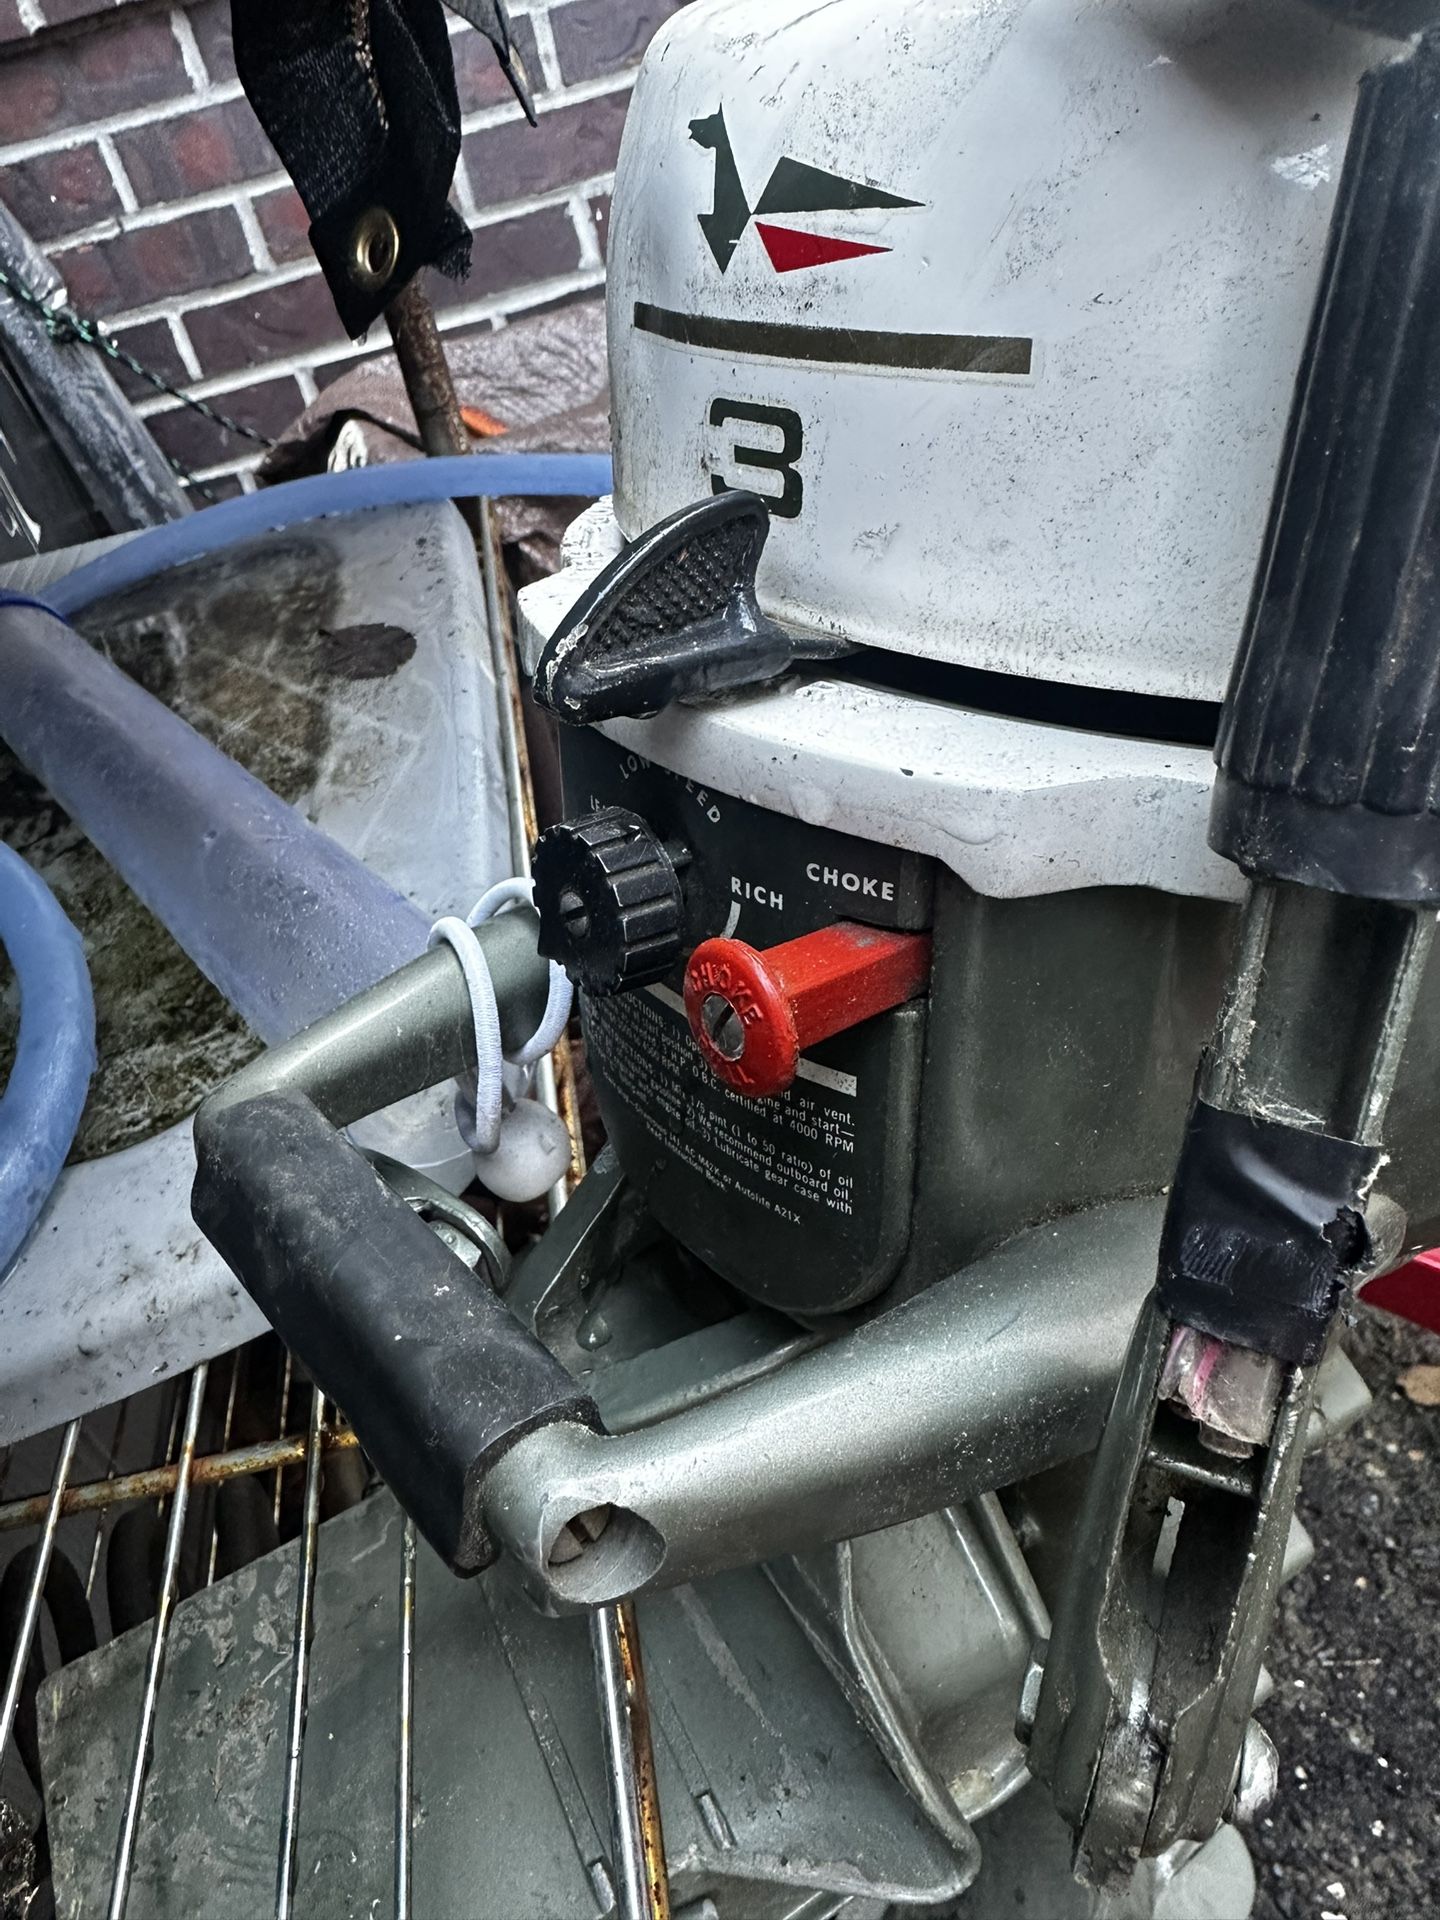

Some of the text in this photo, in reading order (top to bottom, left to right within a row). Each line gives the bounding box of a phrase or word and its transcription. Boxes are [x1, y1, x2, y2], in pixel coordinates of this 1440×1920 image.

[709, 396, 803, 519] 3
[731, 875, 784, 911] RICH
[806, 862, 895, 902] CHOKE
[784, 1105, 807, 1122] and
[799, 1096, 816, 1110] air
[823, 1106, 856, 1126] vent.
[709, 1110, 727, 1129] pint
[747, 1131, 758, 1147] to
[762, 1139, 776, 1156] 50
[781, 1150, 813, 1175] ratio)
[819, 1168, 832, 1180] of
[838, 1175, 854, 1189] oil
[772, 1113, 783, 1126] at
[789, 1119, 819, 1140] 4000
[825, 1133, 855, 1154] RPM
[714, 1125, 772, 1166] recommend
[776, 1162, 828, 1193] outboard
[833, 1187, 854, 1204] oil.
[714, 1137, 760, 1173] Lubricate
[764, 1168, 789, 1188] gear
[793, 1182, 821, 1202] case
[826, 1197, 854, 1216] with
